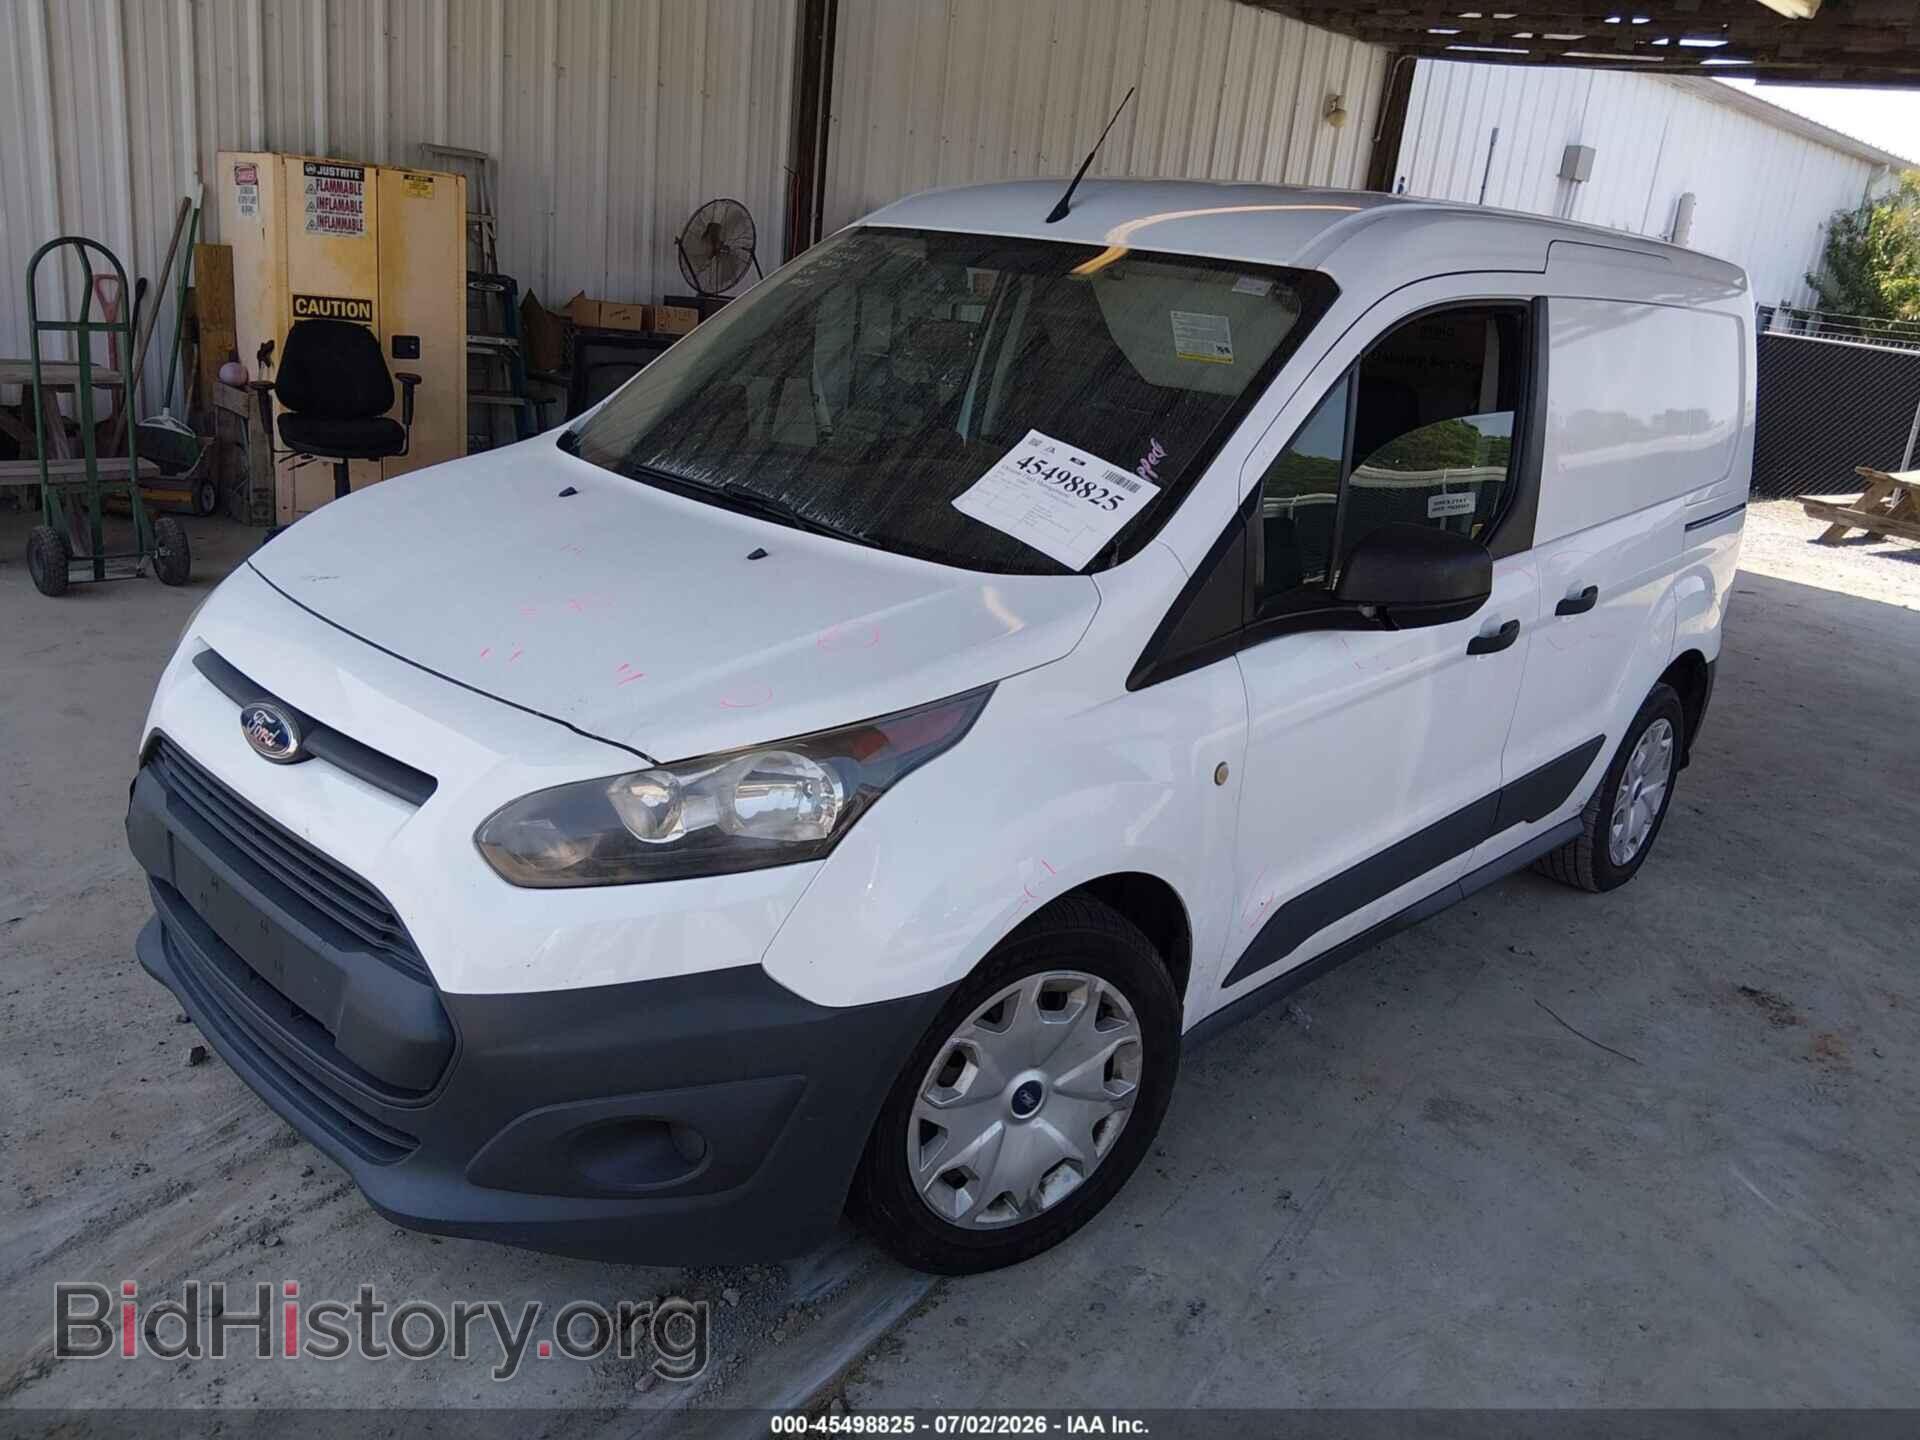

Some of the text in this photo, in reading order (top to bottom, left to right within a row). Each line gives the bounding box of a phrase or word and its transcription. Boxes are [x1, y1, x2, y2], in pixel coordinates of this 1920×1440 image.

[316, 166, 361, 181] JUSTRITE
[315, 179, 363, 196] FLAMMABLE
[316, 196, 363, 214] INFLAMABLE
[316, 214, 363, 233] INFLAMMABLE
[295, 298, 371, 319] CAUTION
[1016, 455, 1126, 511] 45498825
[247, 710, 281, 747] Ford
